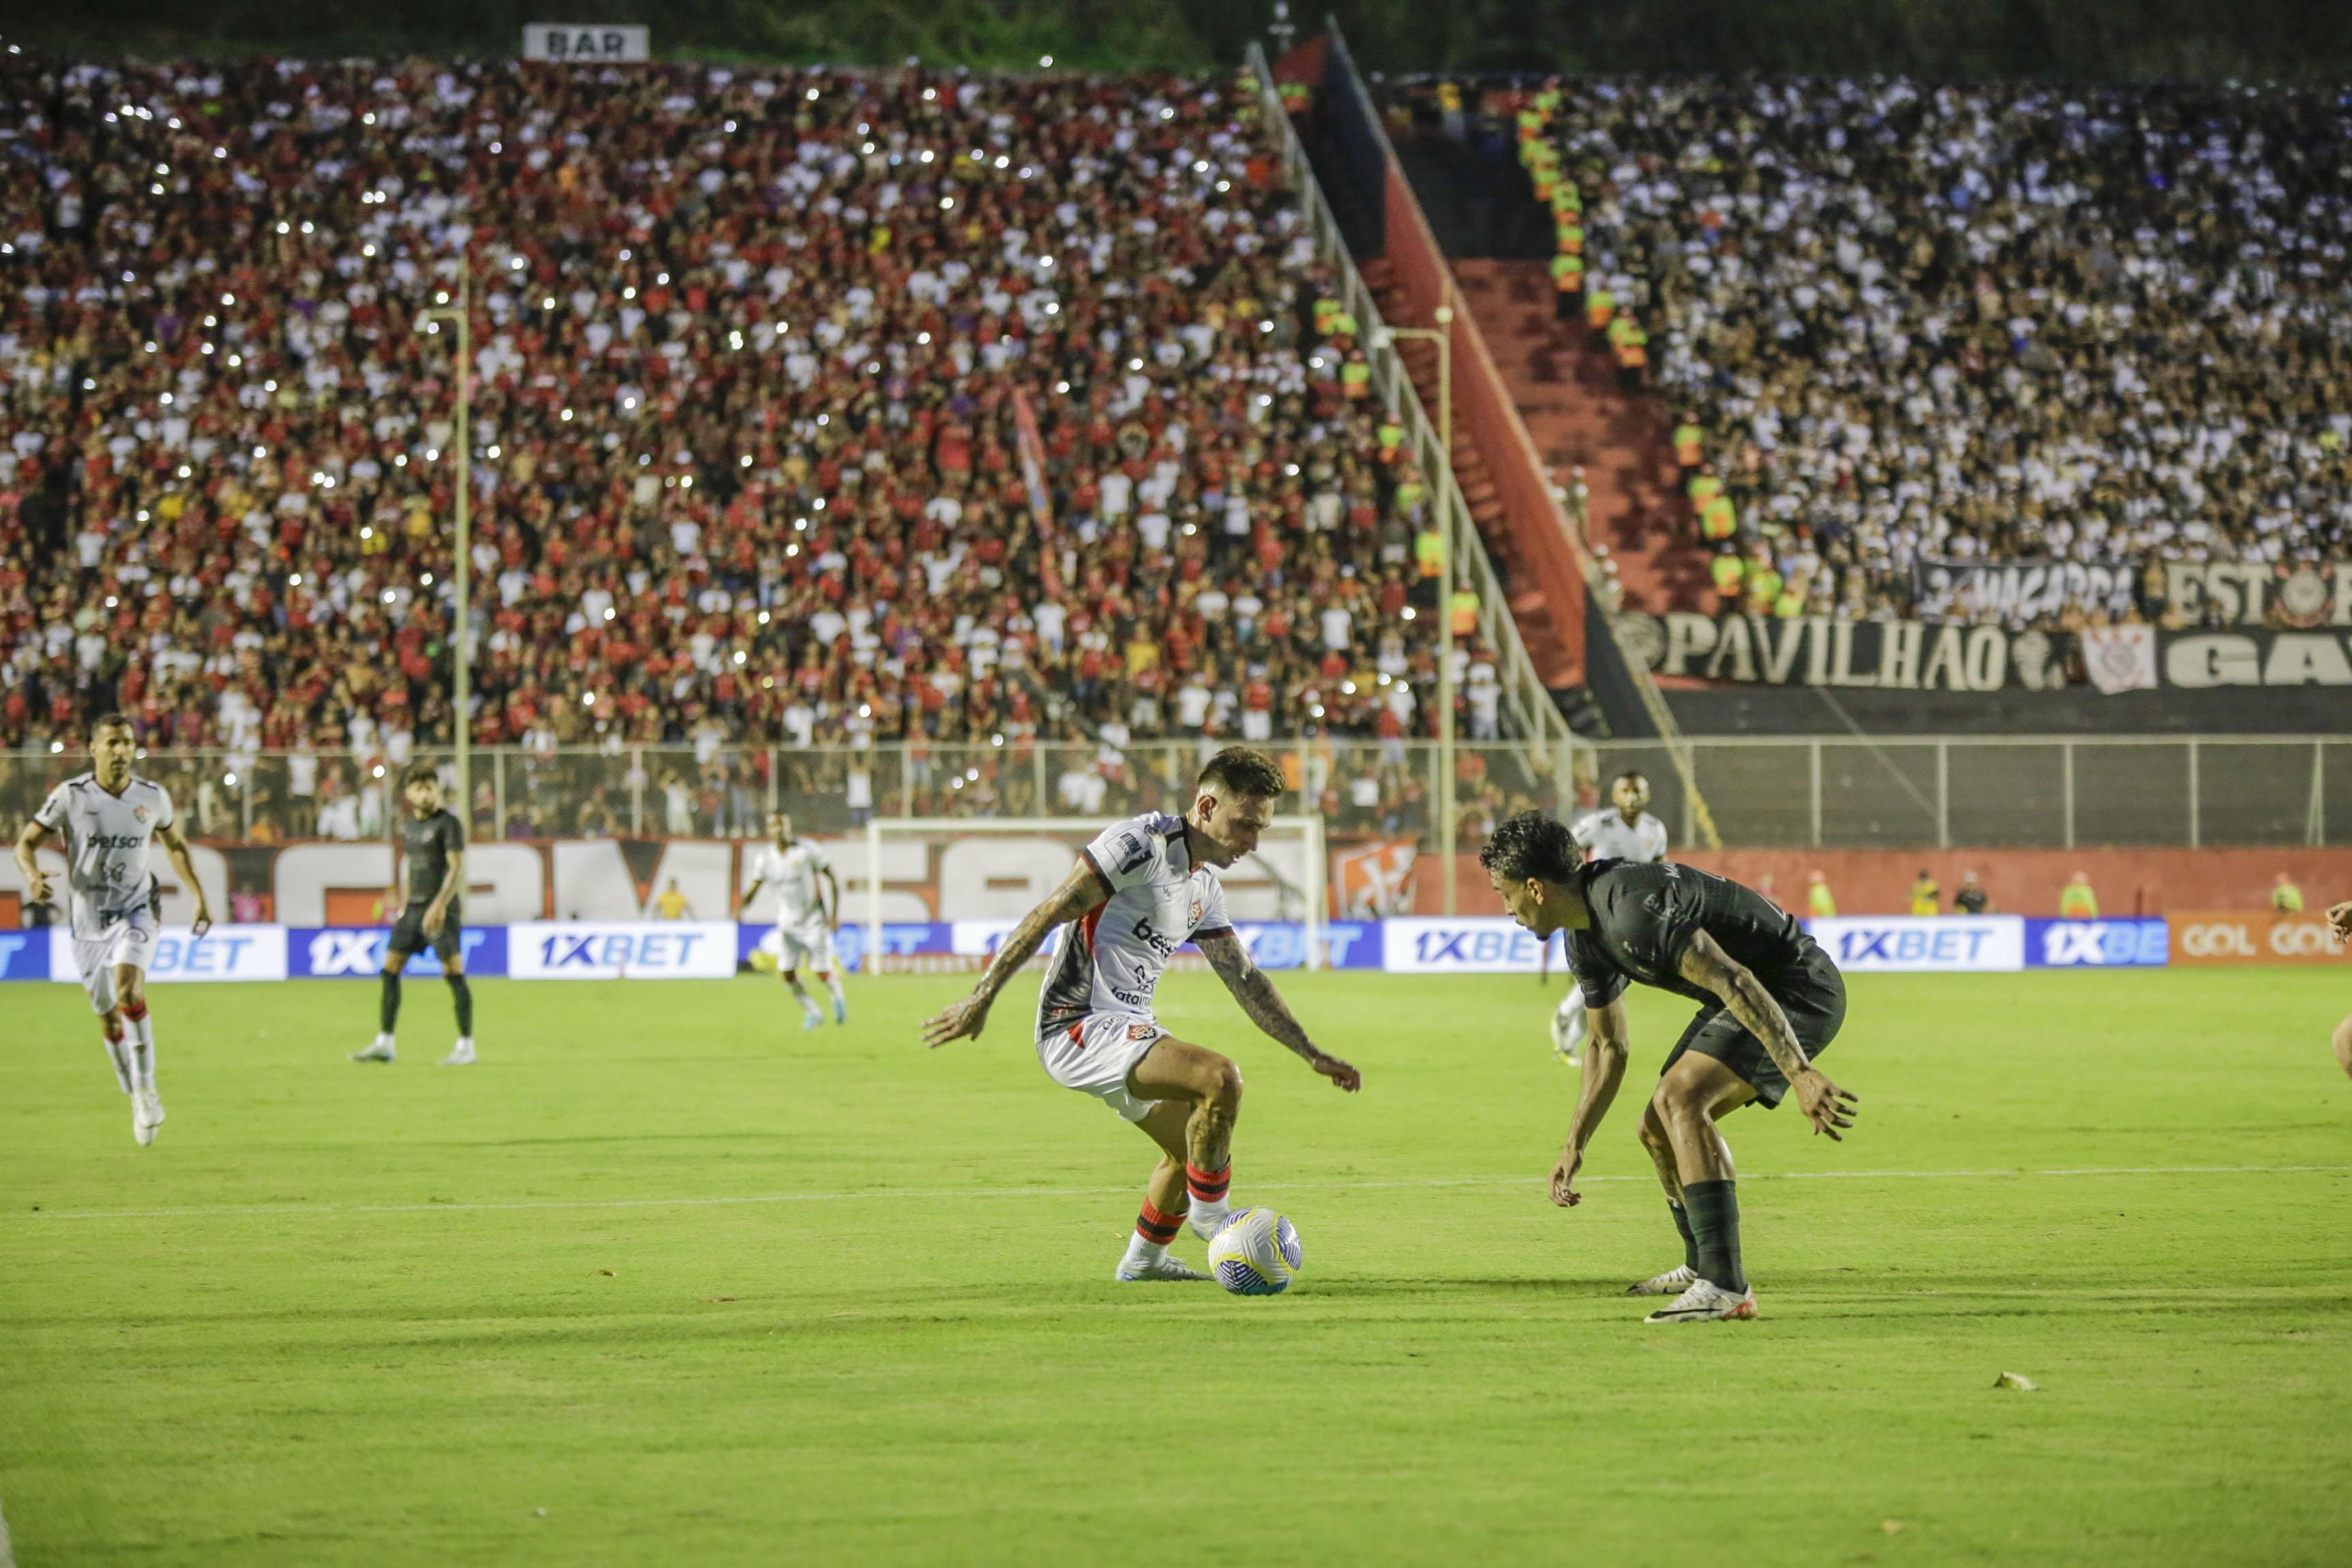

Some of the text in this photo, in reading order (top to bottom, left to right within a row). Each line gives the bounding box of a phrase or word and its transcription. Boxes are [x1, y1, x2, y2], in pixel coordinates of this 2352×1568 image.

[548, 31, 625, 55] BAR
[2167, 633, 2352, 688] GA
[541, 933, 704, 969] 1XBET
[1839, 929, 1994, 961] 1XBET
[2182, 923, 2257, 956] GOL
